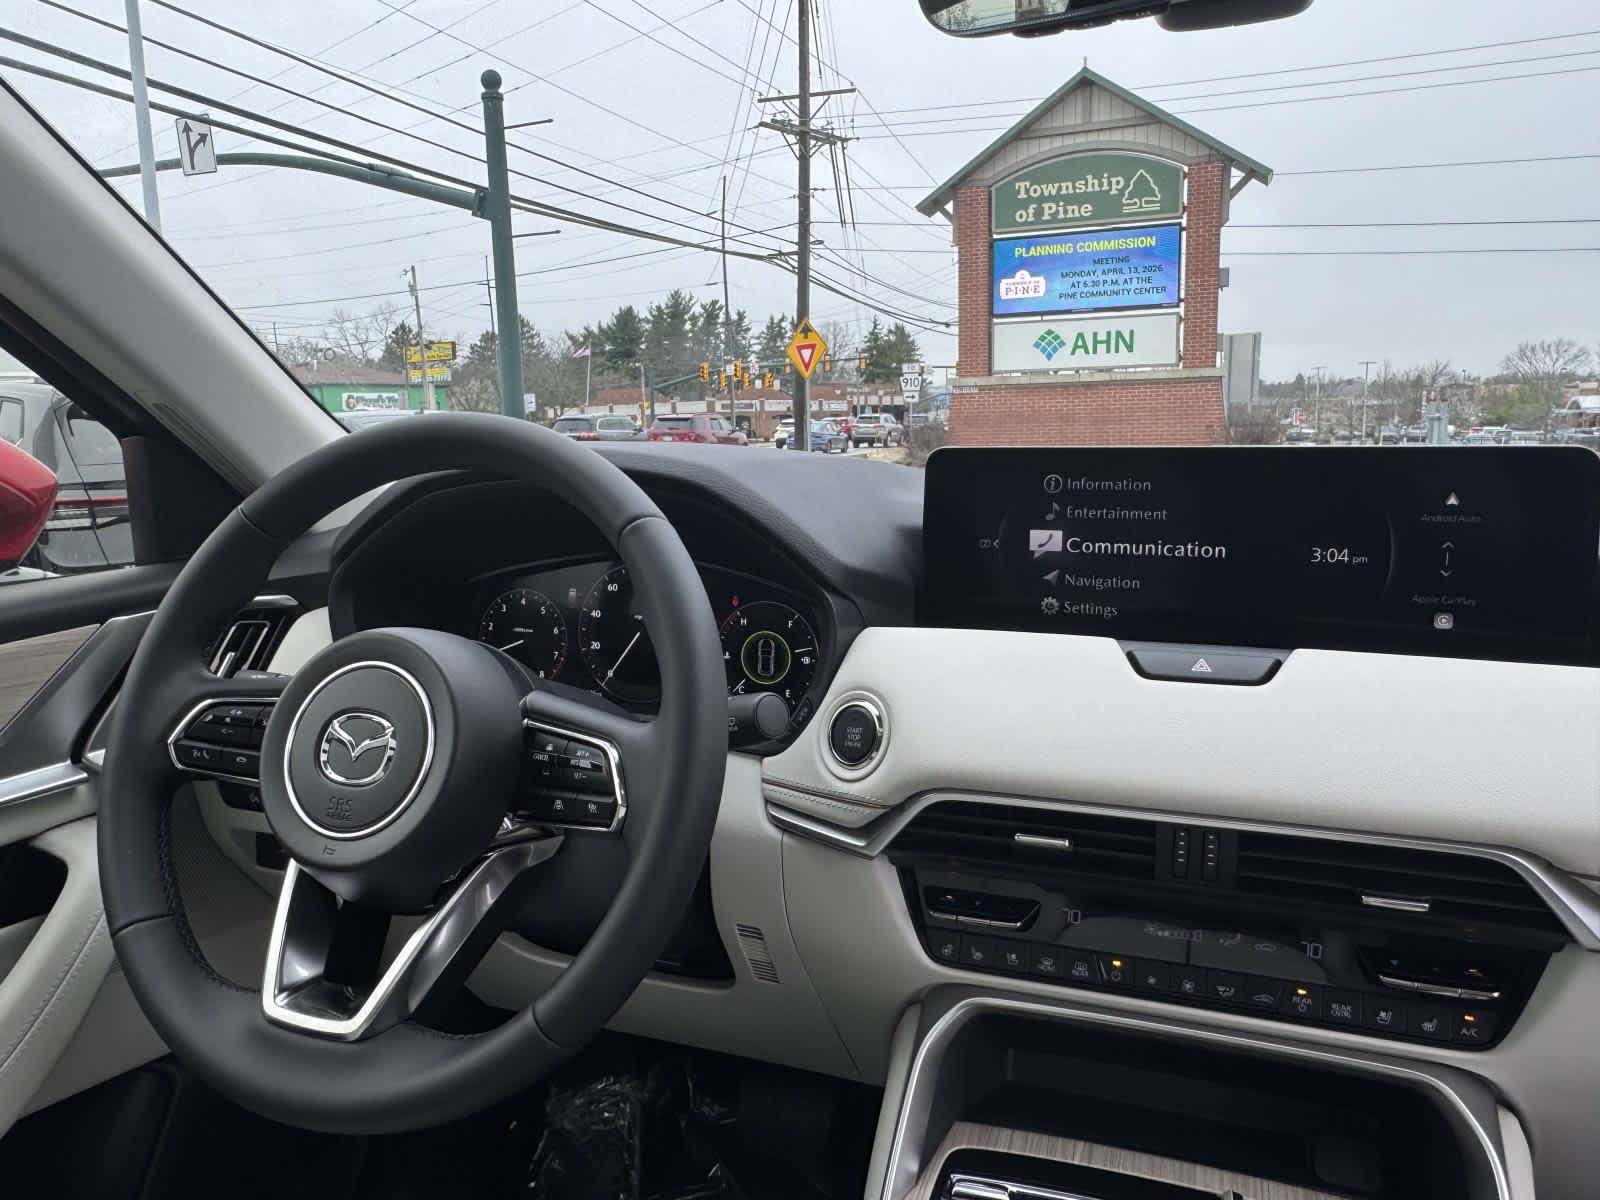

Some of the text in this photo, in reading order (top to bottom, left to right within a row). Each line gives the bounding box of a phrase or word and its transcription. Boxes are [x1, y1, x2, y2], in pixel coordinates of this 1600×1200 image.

[1015, 174, 1125, 199] Township
[1015, 202, 1093, 223] of Pine
[1014, 235, 1156, 258] PLANNING COMMISSION
[1092, 256, 1131, 266] MEETING
[1060, 264, 1164, 280] MONDAY, APRIL 13, 2026
[1070, 280, 1081, 289] AT
[1102, 277, 1121, 287] P.M.
[1122, 277, 1134, 286] AT
[1135, 275, 1153, 285] THE
[1059, 286, 1167, 300] PINE COMMUNITY CENTER
[1070, 329, 1135, 356] AHN
[902, 377, 919, 388] 910
[1066, 477, 1152, 491] Information
[1066, 506, 1168, 521] Entertainment
[1066, 537, 1227, 559] Communication
[1310, 547, 1368, 565] 3:04 pm
[607, 583, 618, 592] 60
[1064, 574, 1141, 590] Navigation
[520, 597, 526, 606] 4
[501, 604, 507, 612] 3
[540, 606, 546, 615] 5
[1064, 601, 1118, 619] Settings
[590, 609, 601, 619] 40
[488, 623, 494, 631] 2
[740, 617, 747, 626] H
[788, 620, 793, 629] F
[553, 626, 559, 635] 6
[590, 641, 601, 650] 20
[553, 651, 559, 660] 7
[539, 670, 545, 679] 8
[785, 689, 791, 698] E
[1460, 1026, 1478, 1038] A/C
